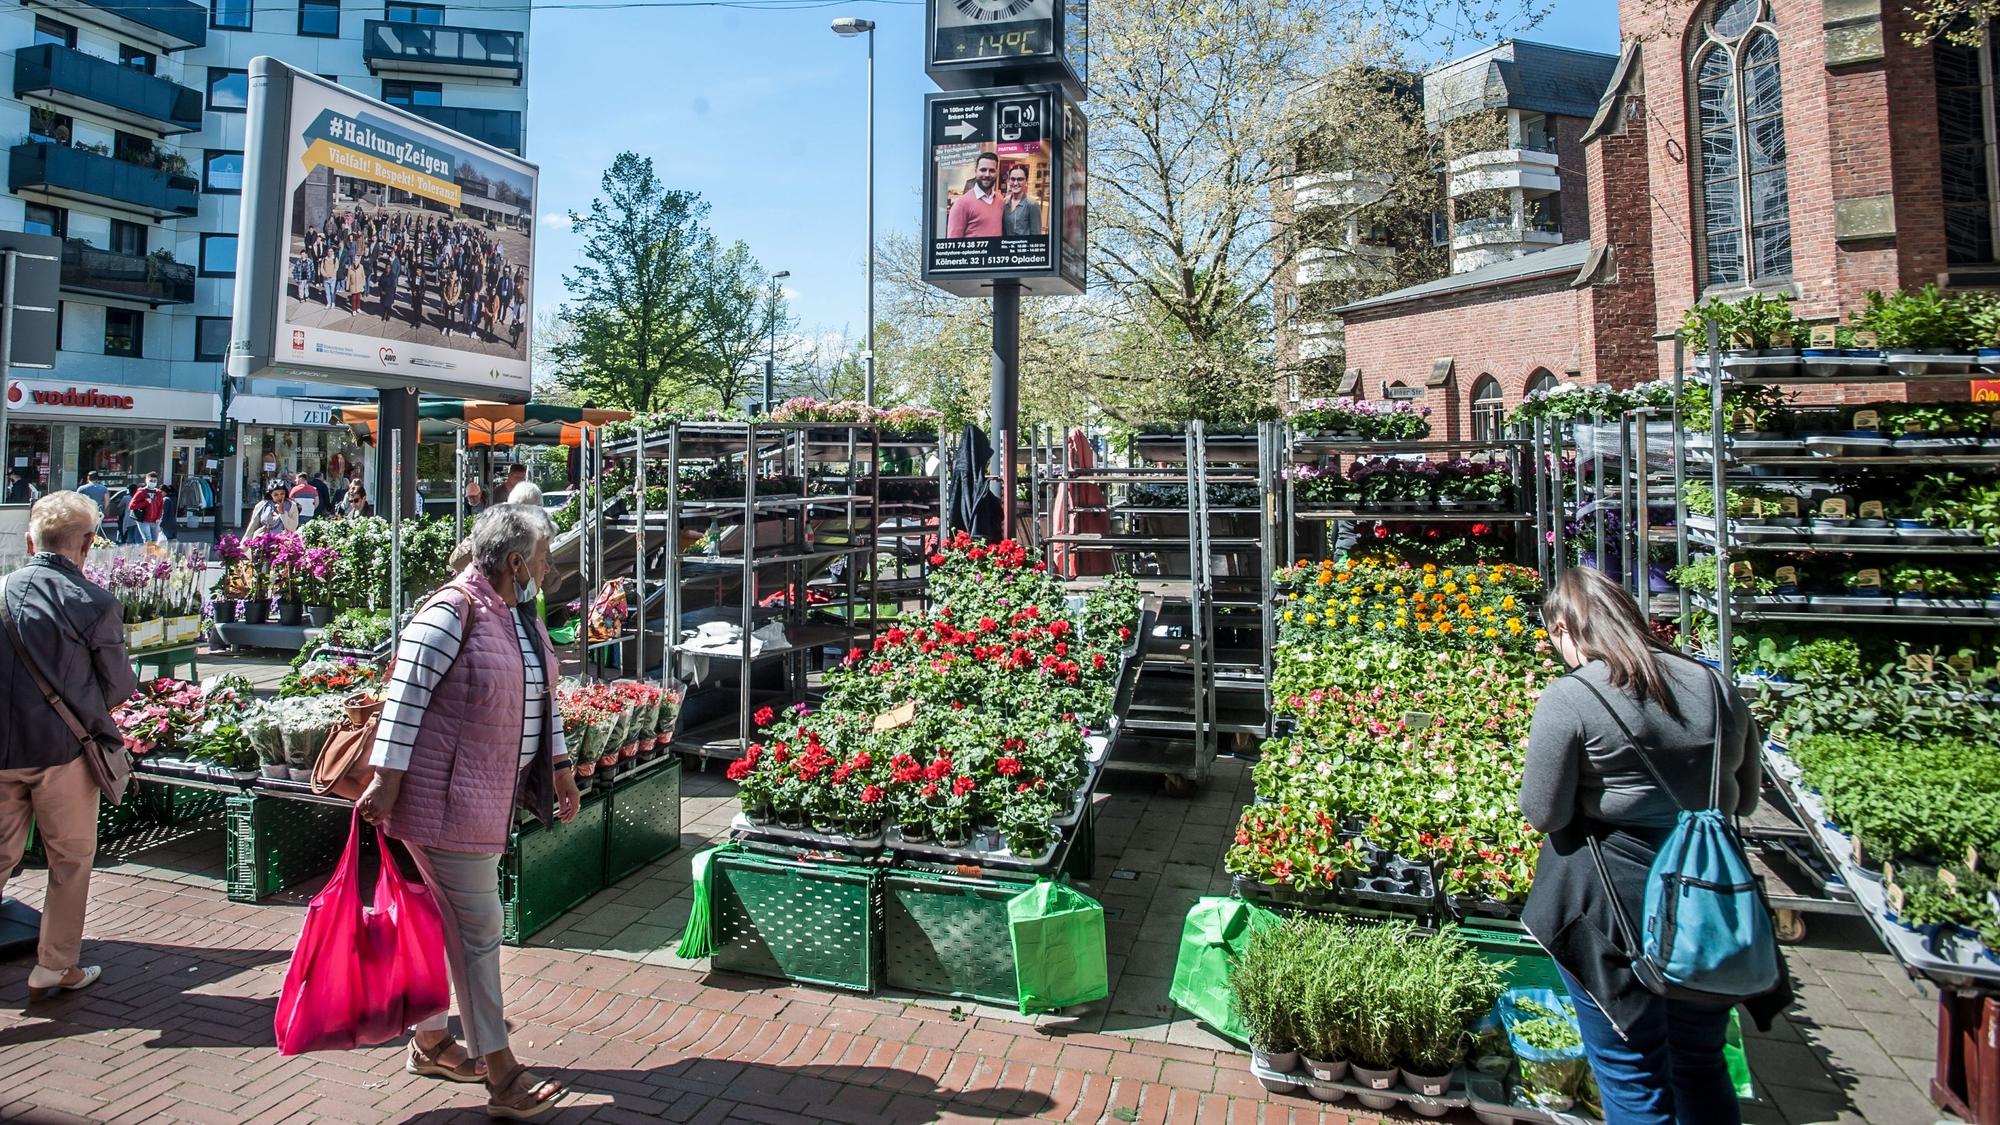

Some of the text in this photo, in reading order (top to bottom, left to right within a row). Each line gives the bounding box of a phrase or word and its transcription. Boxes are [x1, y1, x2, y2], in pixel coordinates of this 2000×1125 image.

[329, 117, 449, 175] #HaltungZeigen
[328, 147, 458, 201] Vielfalt! Respekt! Toleranz!
[957, 241, 966, 249] 74
[976, 240, 989, 248] 777
[935, 257, 969, 266] Kölnerstr.
[987, 256, 1010, 264] 51379
[1011, 254, 1046, 264] Opladen
[384, 354, 397, 362] AWO
[33, 387, 134, 409] vodafone
